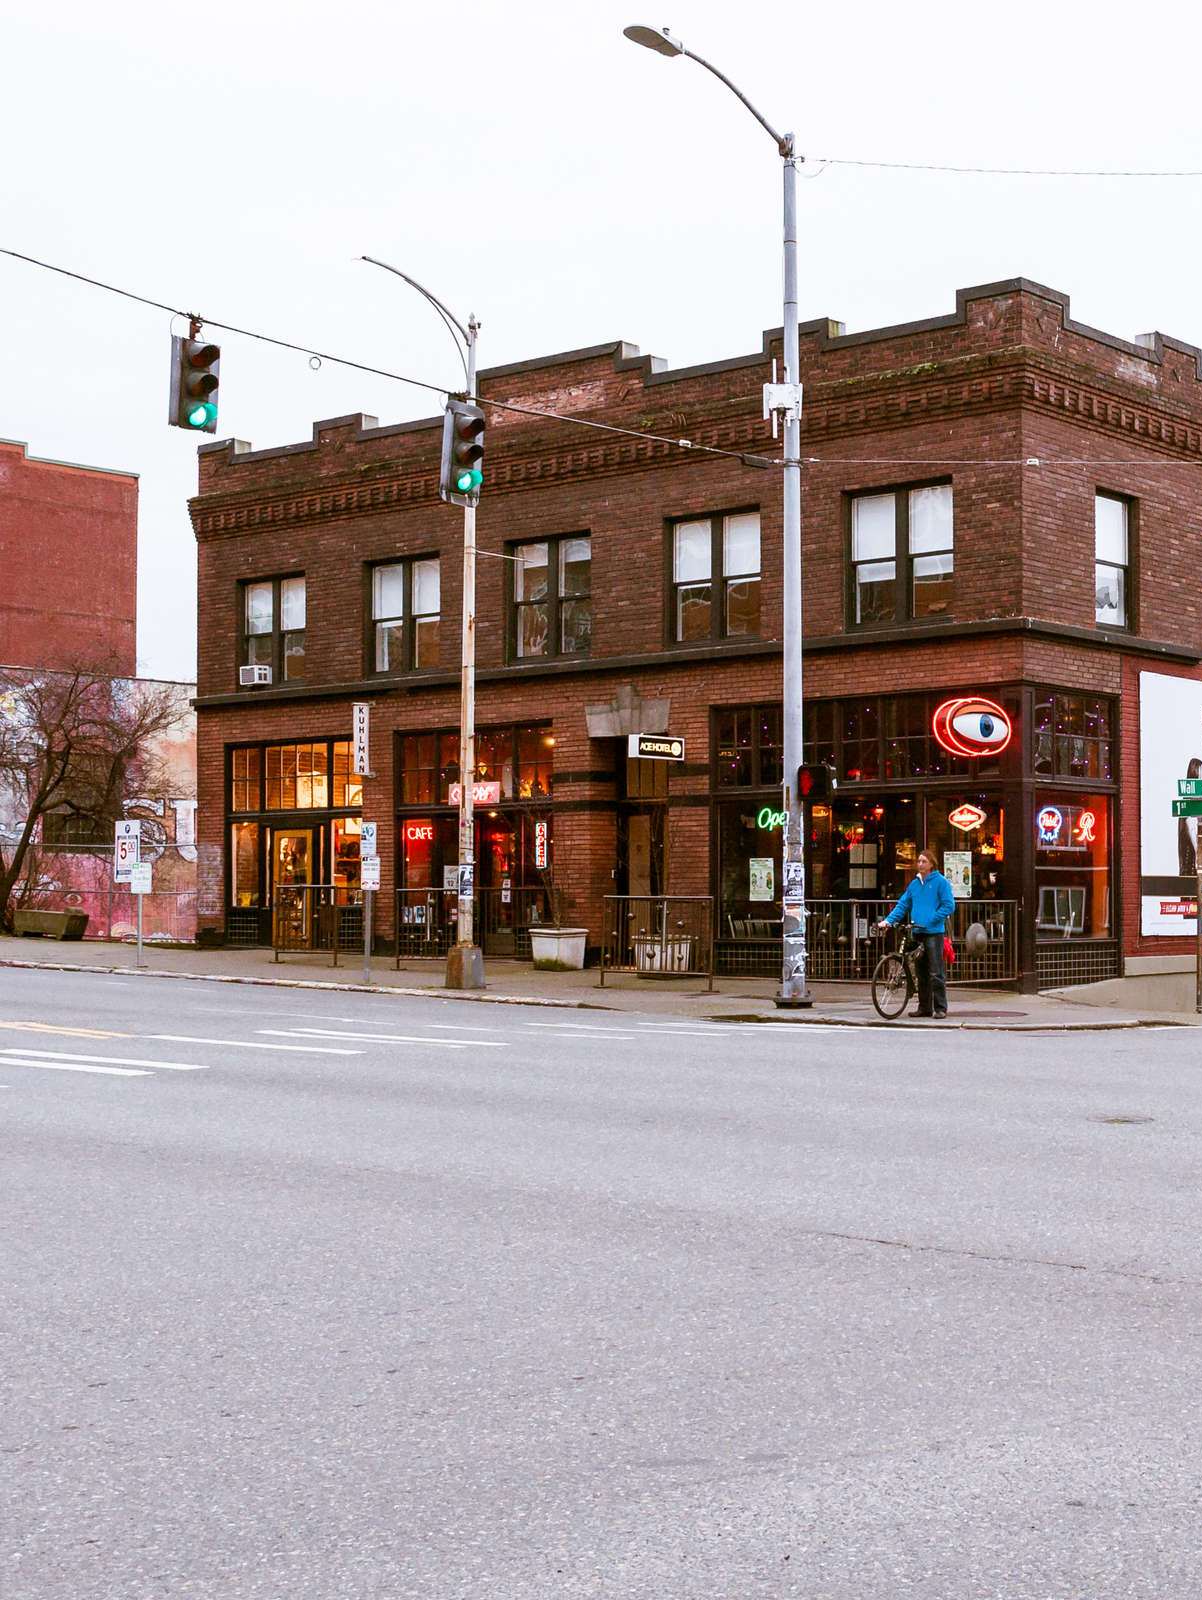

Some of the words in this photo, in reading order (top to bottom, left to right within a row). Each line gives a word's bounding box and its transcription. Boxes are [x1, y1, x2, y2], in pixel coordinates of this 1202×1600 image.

[653, 743, 672, 753] HOTEL
[1180, 780, 1196, 794] Wall
[758, 807, 785, 831] Ope
[407, 827, 433, 840] CAFE
